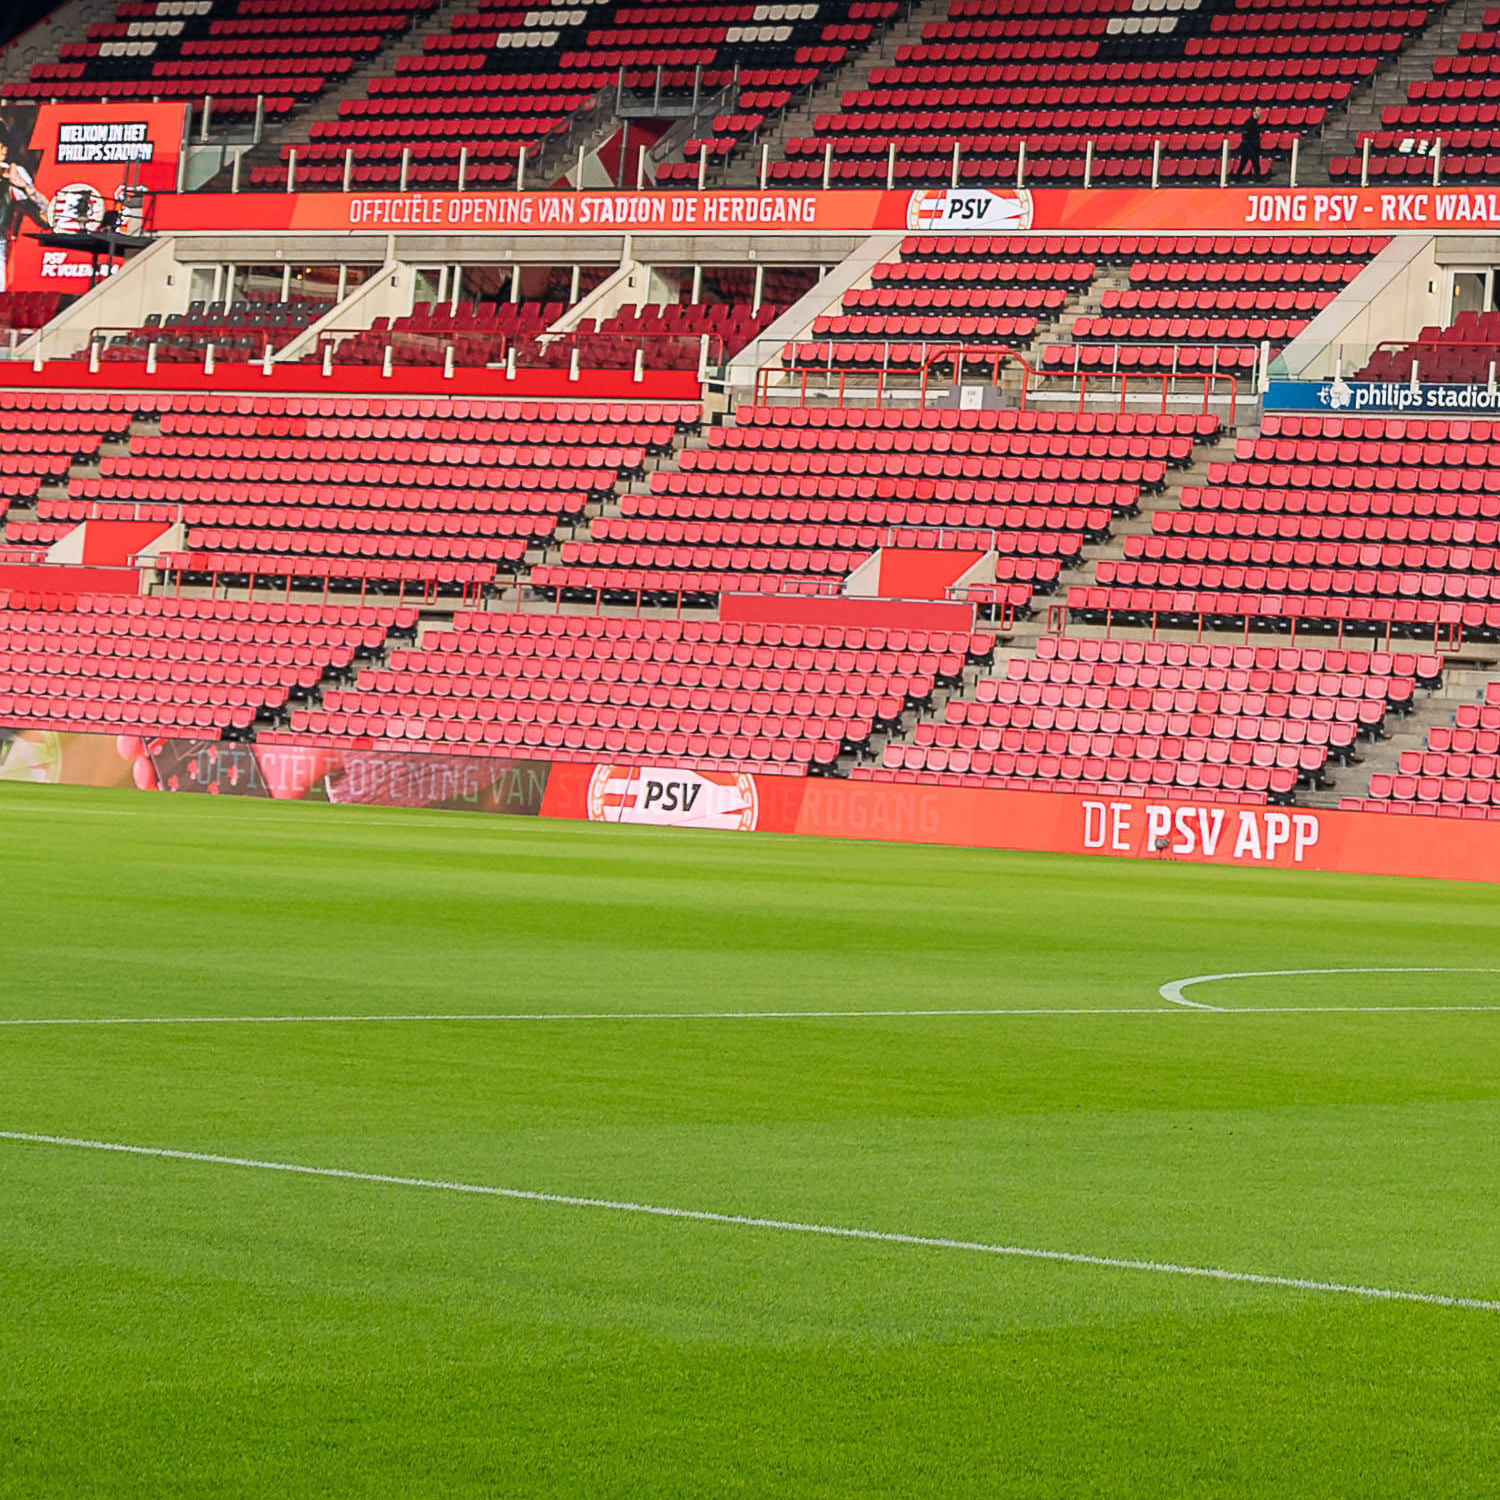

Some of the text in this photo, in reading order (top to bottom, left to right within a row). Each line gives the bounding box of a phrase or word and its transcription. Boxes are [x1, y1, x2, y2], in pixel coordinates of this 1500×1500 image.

[60, 124, 147, 142] WELKOM IN HET
[58, 144, 103, 161] PHILIPS
[349, 195, 816, 224] OFFICIËLE OPENING VAN STADION DE HERDGANG
[948, 198, 992, 220] PSV
[1245, 195, 1307, 222] JONG
[1313, 195, 1358, 221] PSV
[1380, 195, 1427, 221] RKC
[1354, 381, 1421, 411] philips
[351, 758, 478, 803] OPENING
[490, 763, 546, 806] VAN
[644, 781, 701, 812] PSV
[1083, 801, 1319, 862] DE PSV APP
